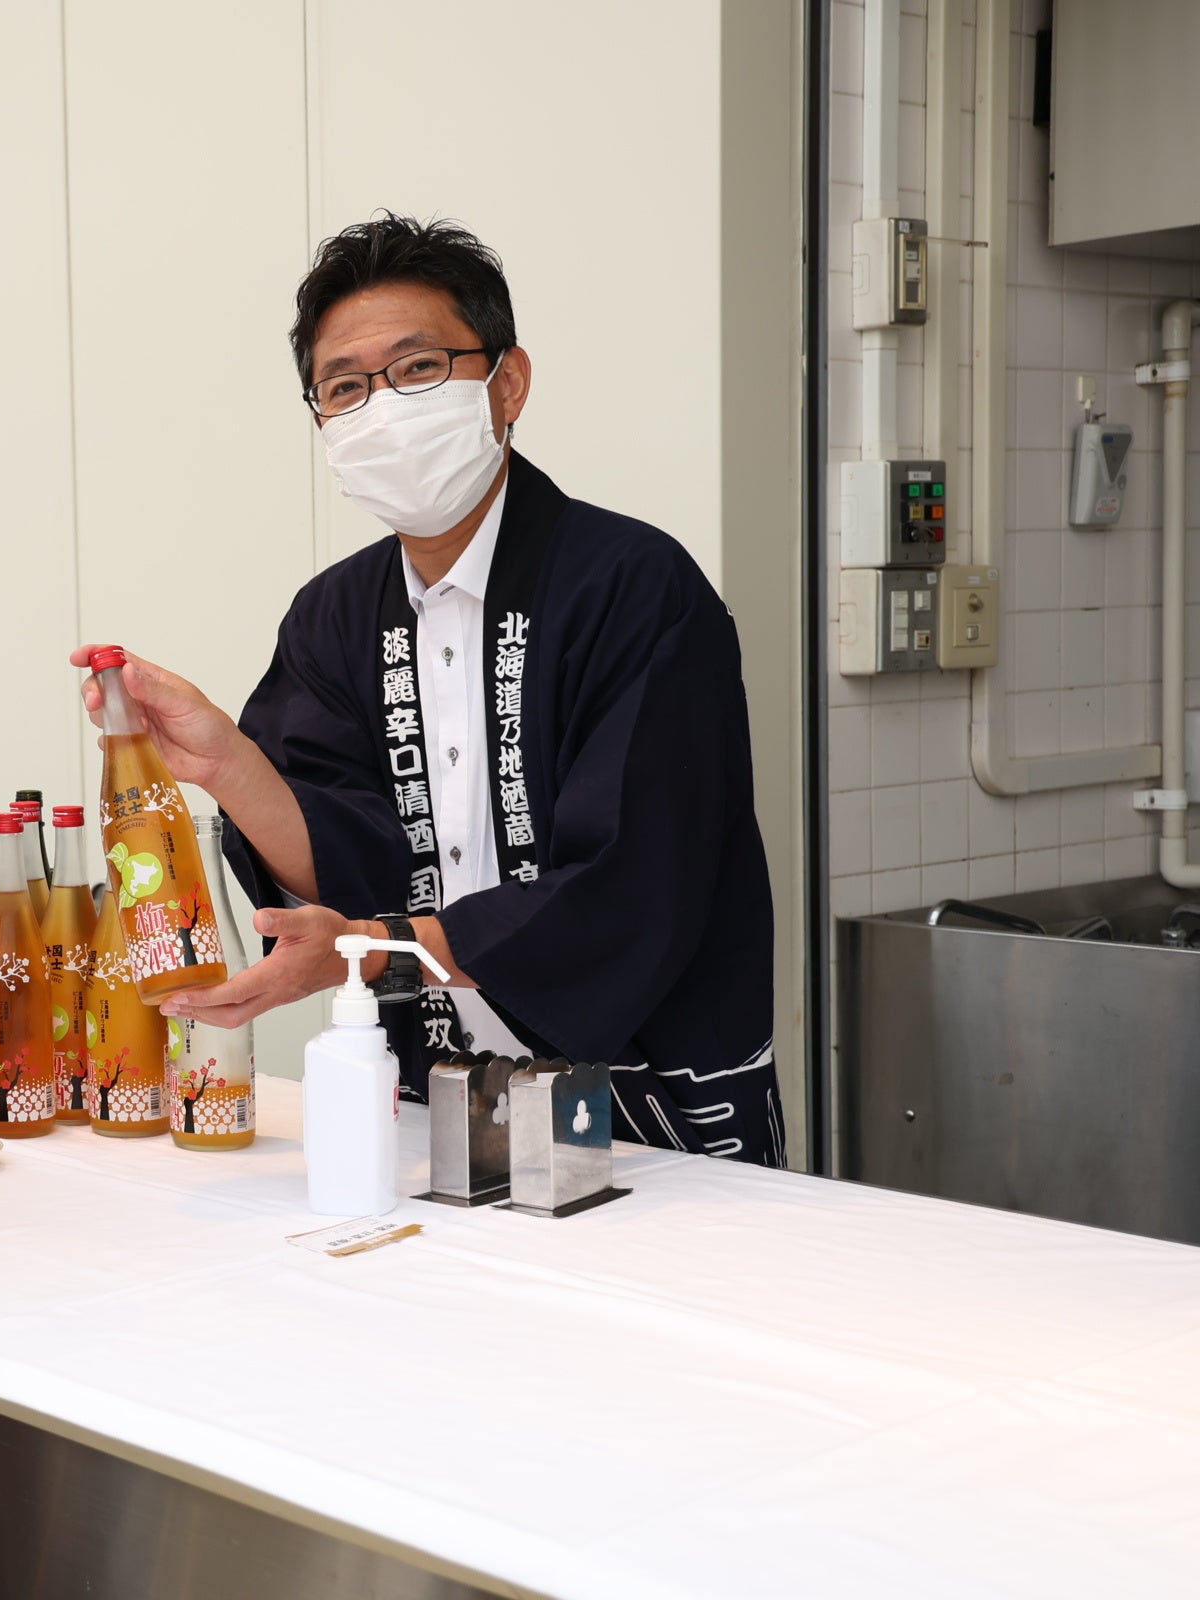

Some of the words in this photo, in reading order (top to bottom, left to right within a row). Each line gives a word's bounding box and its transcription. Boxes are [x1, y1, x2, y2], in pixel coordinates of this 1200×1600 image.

[495, 611, 536, 847] 北海道乃地酒蔵
[134, 902, 178, 973] 梅酒
